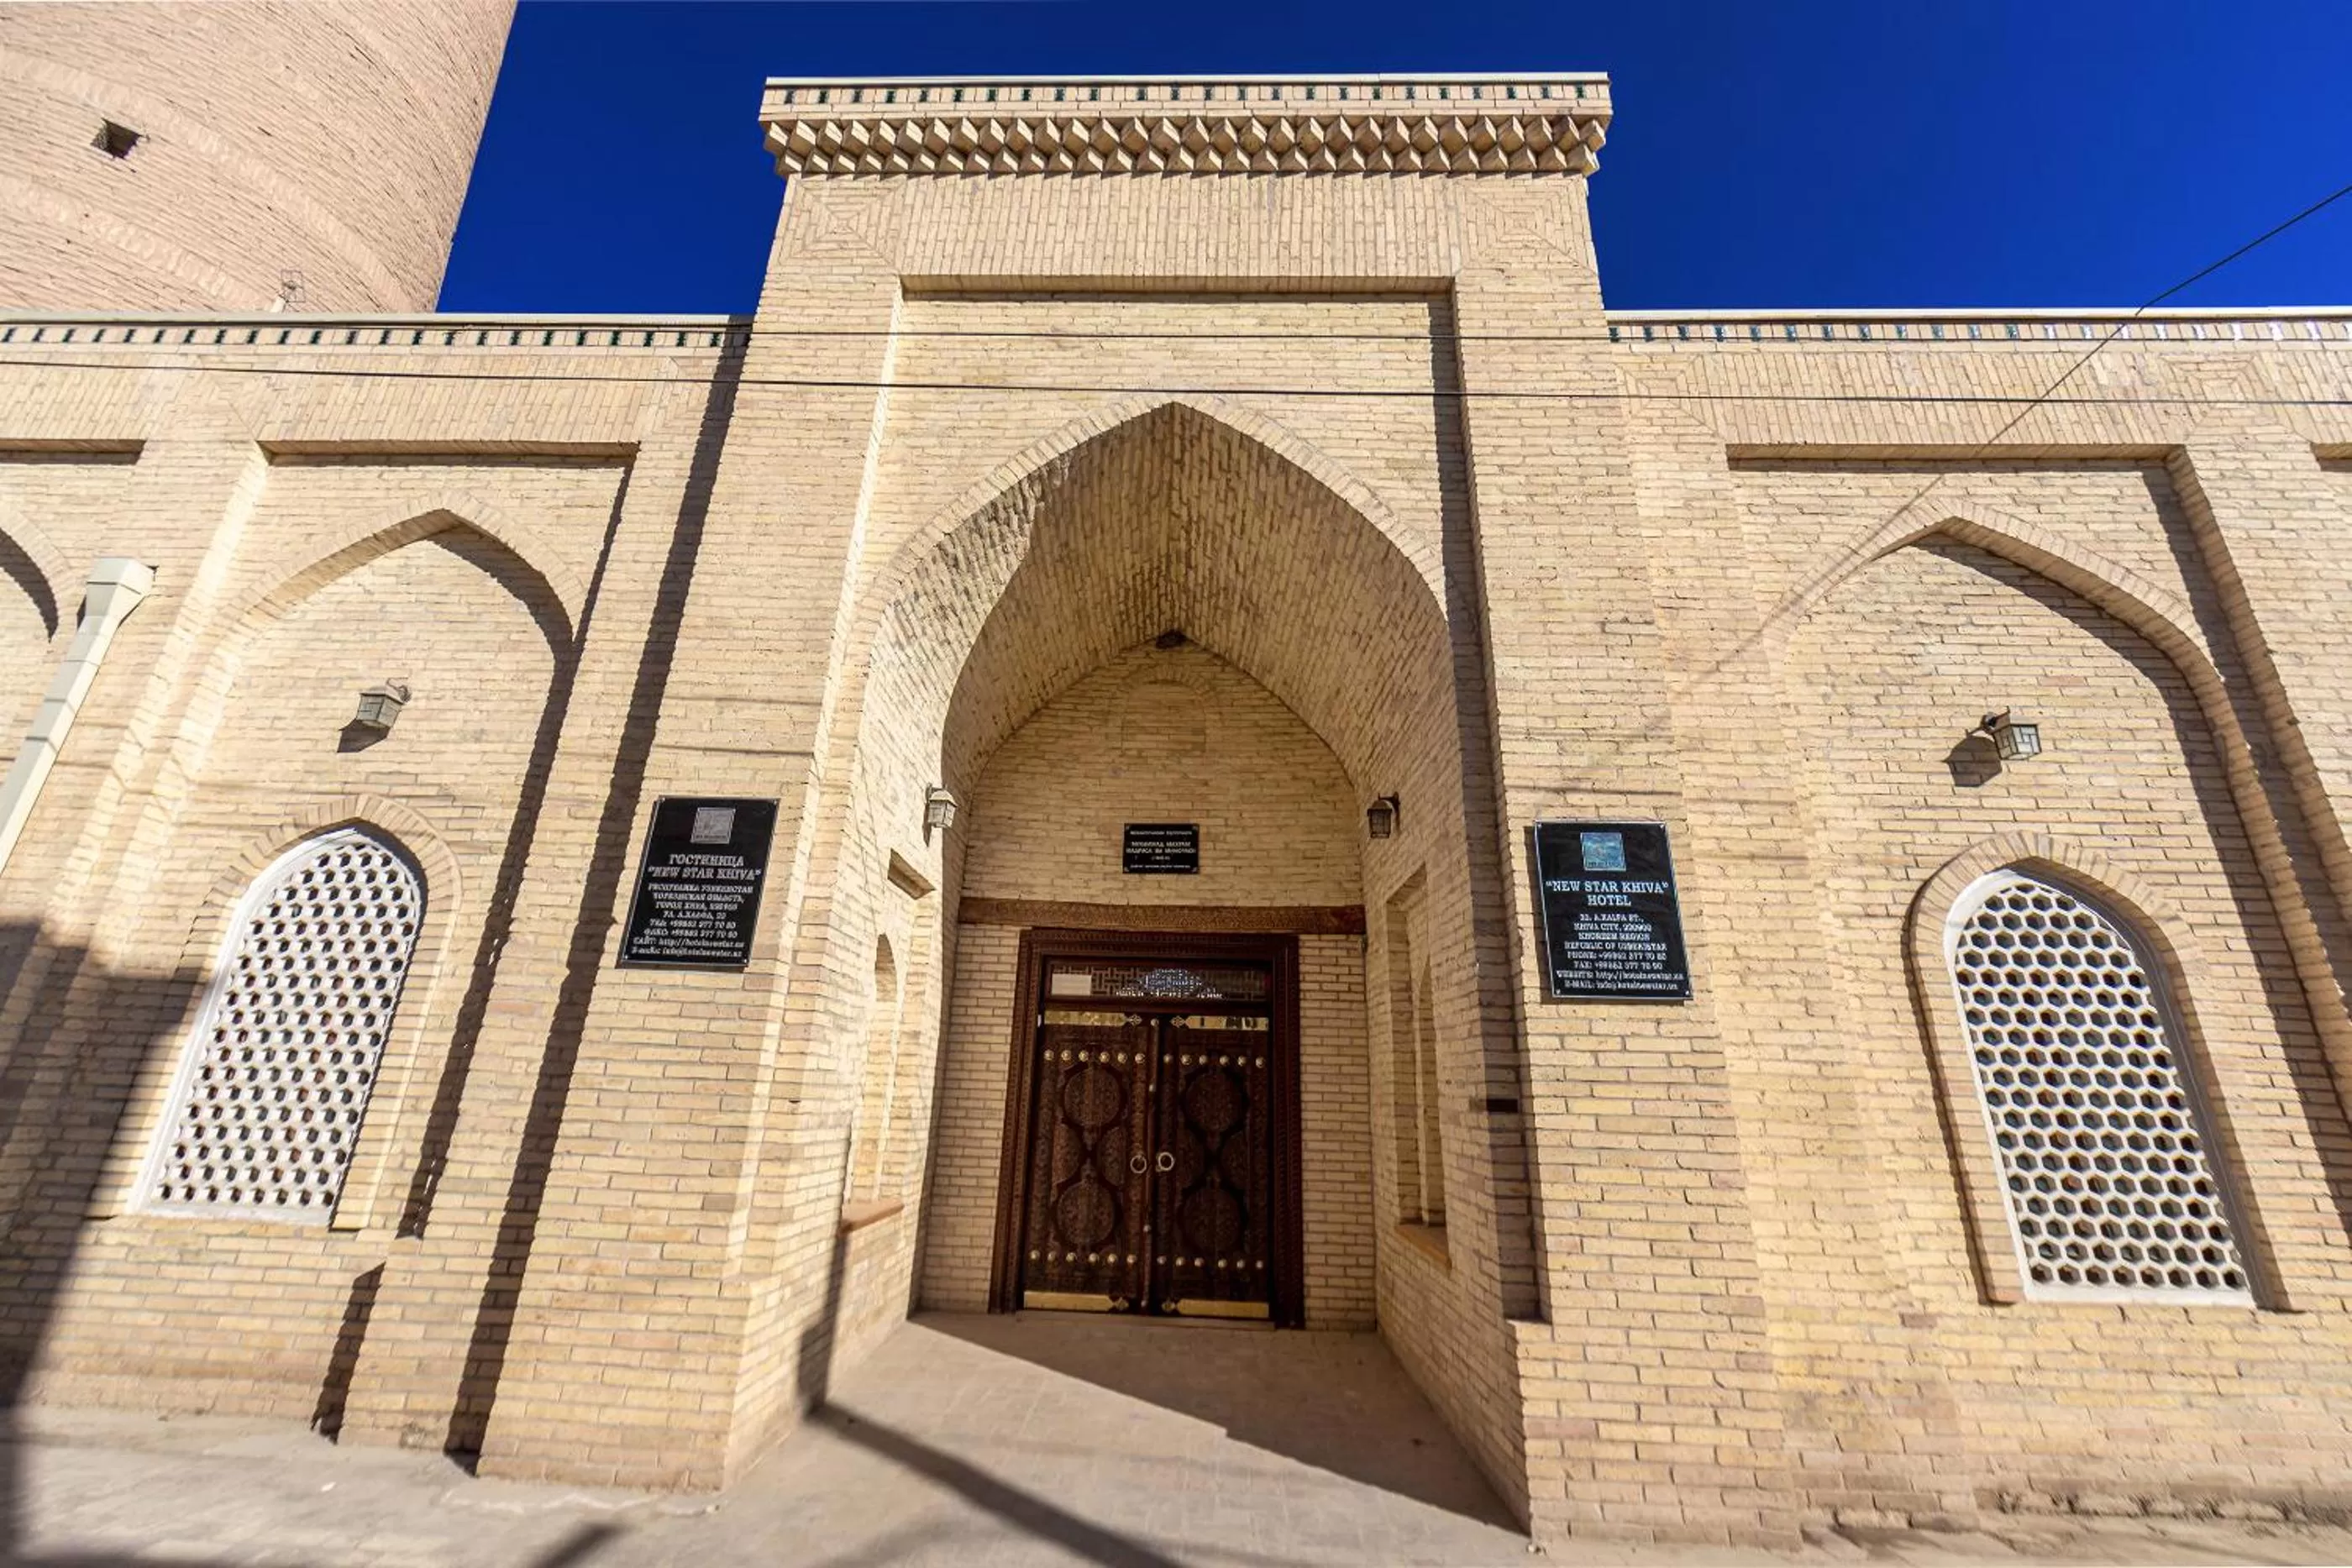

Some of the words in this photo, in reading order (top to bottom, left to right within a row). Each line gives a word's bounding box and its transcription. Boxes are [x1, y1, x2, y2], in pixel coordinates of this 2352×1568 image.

[669, 853, 744, 868] ГОСТИНИЦА
[681, 867, 714, 879] STAR
[1583, 880, 1620, 893] STAR
[1587, 894, 1631, 906] HOTEL
[1573, 922, 1599, 931] KHIVA
[1564, 941, 1604, 950] REPUBLIC
[1604, 941, 1616, 950] OF
